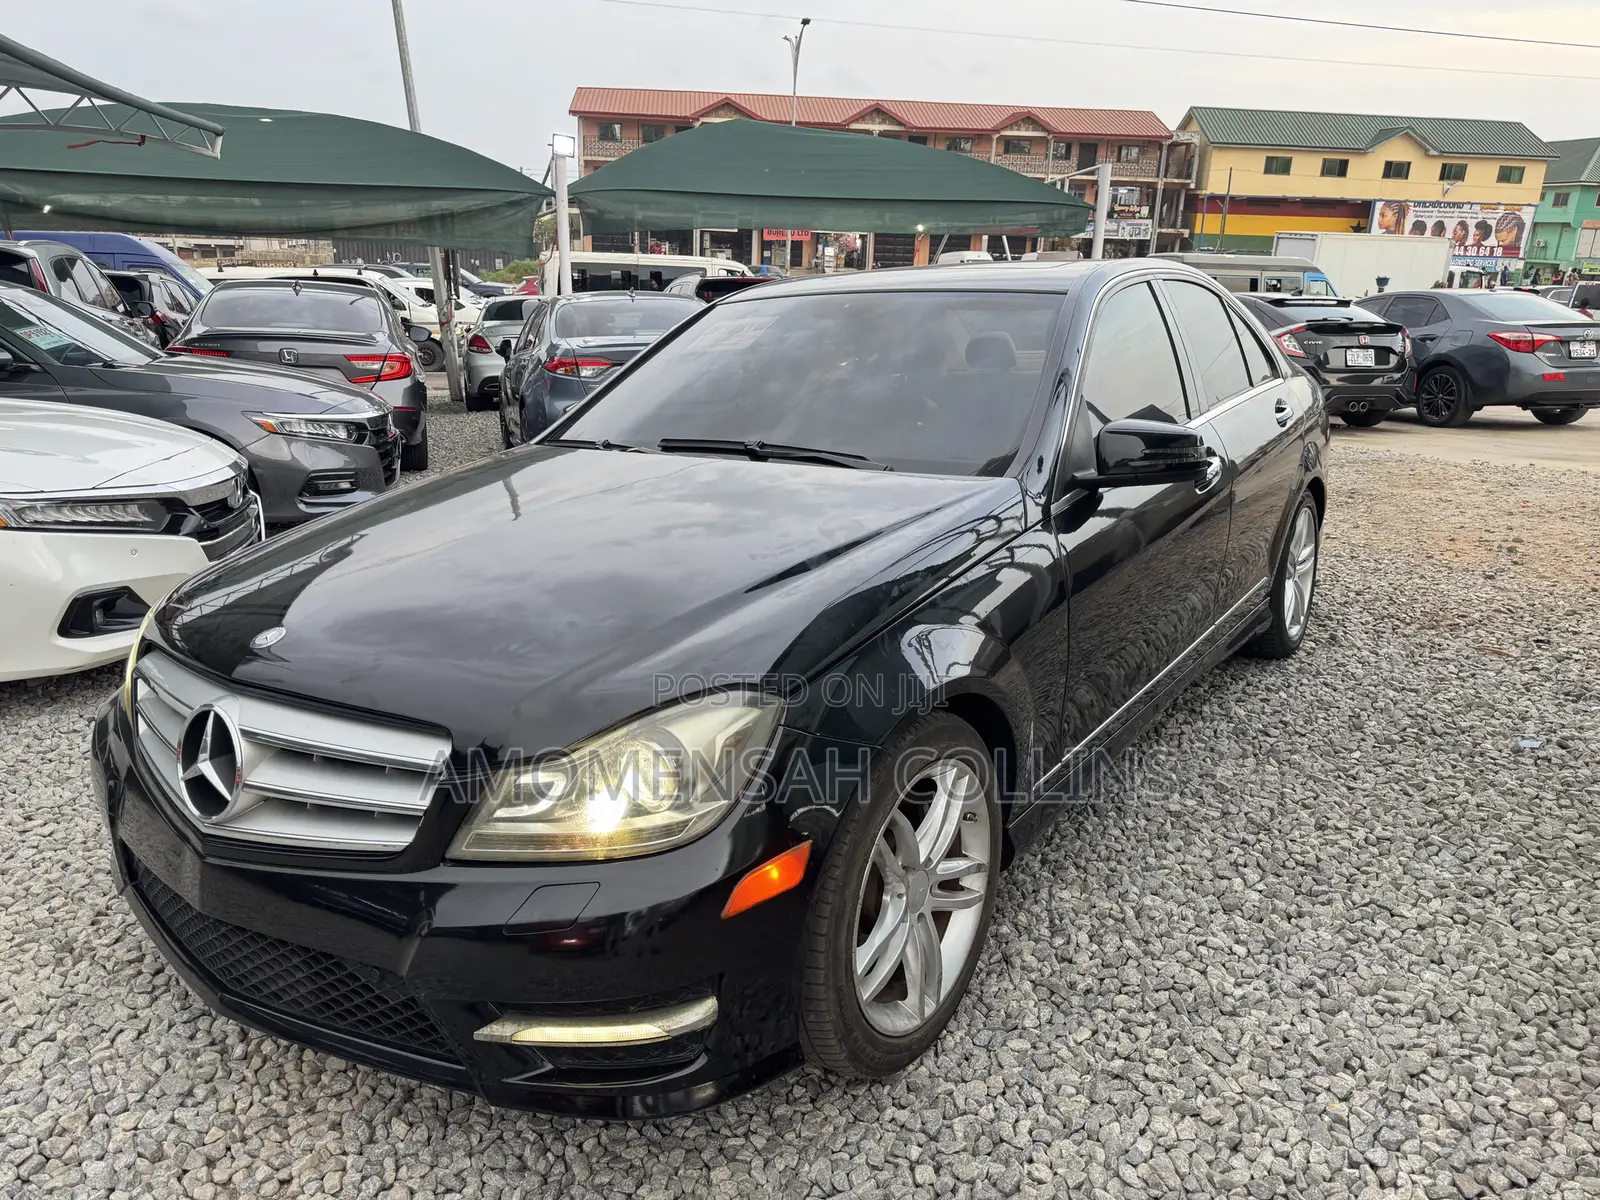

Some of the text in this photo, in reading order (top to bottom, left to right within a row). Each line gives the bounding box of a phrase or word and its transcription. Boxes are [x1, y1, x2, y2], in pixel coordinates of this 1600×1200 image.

[1453, 246, 1503, 257] 44 30 64 18
